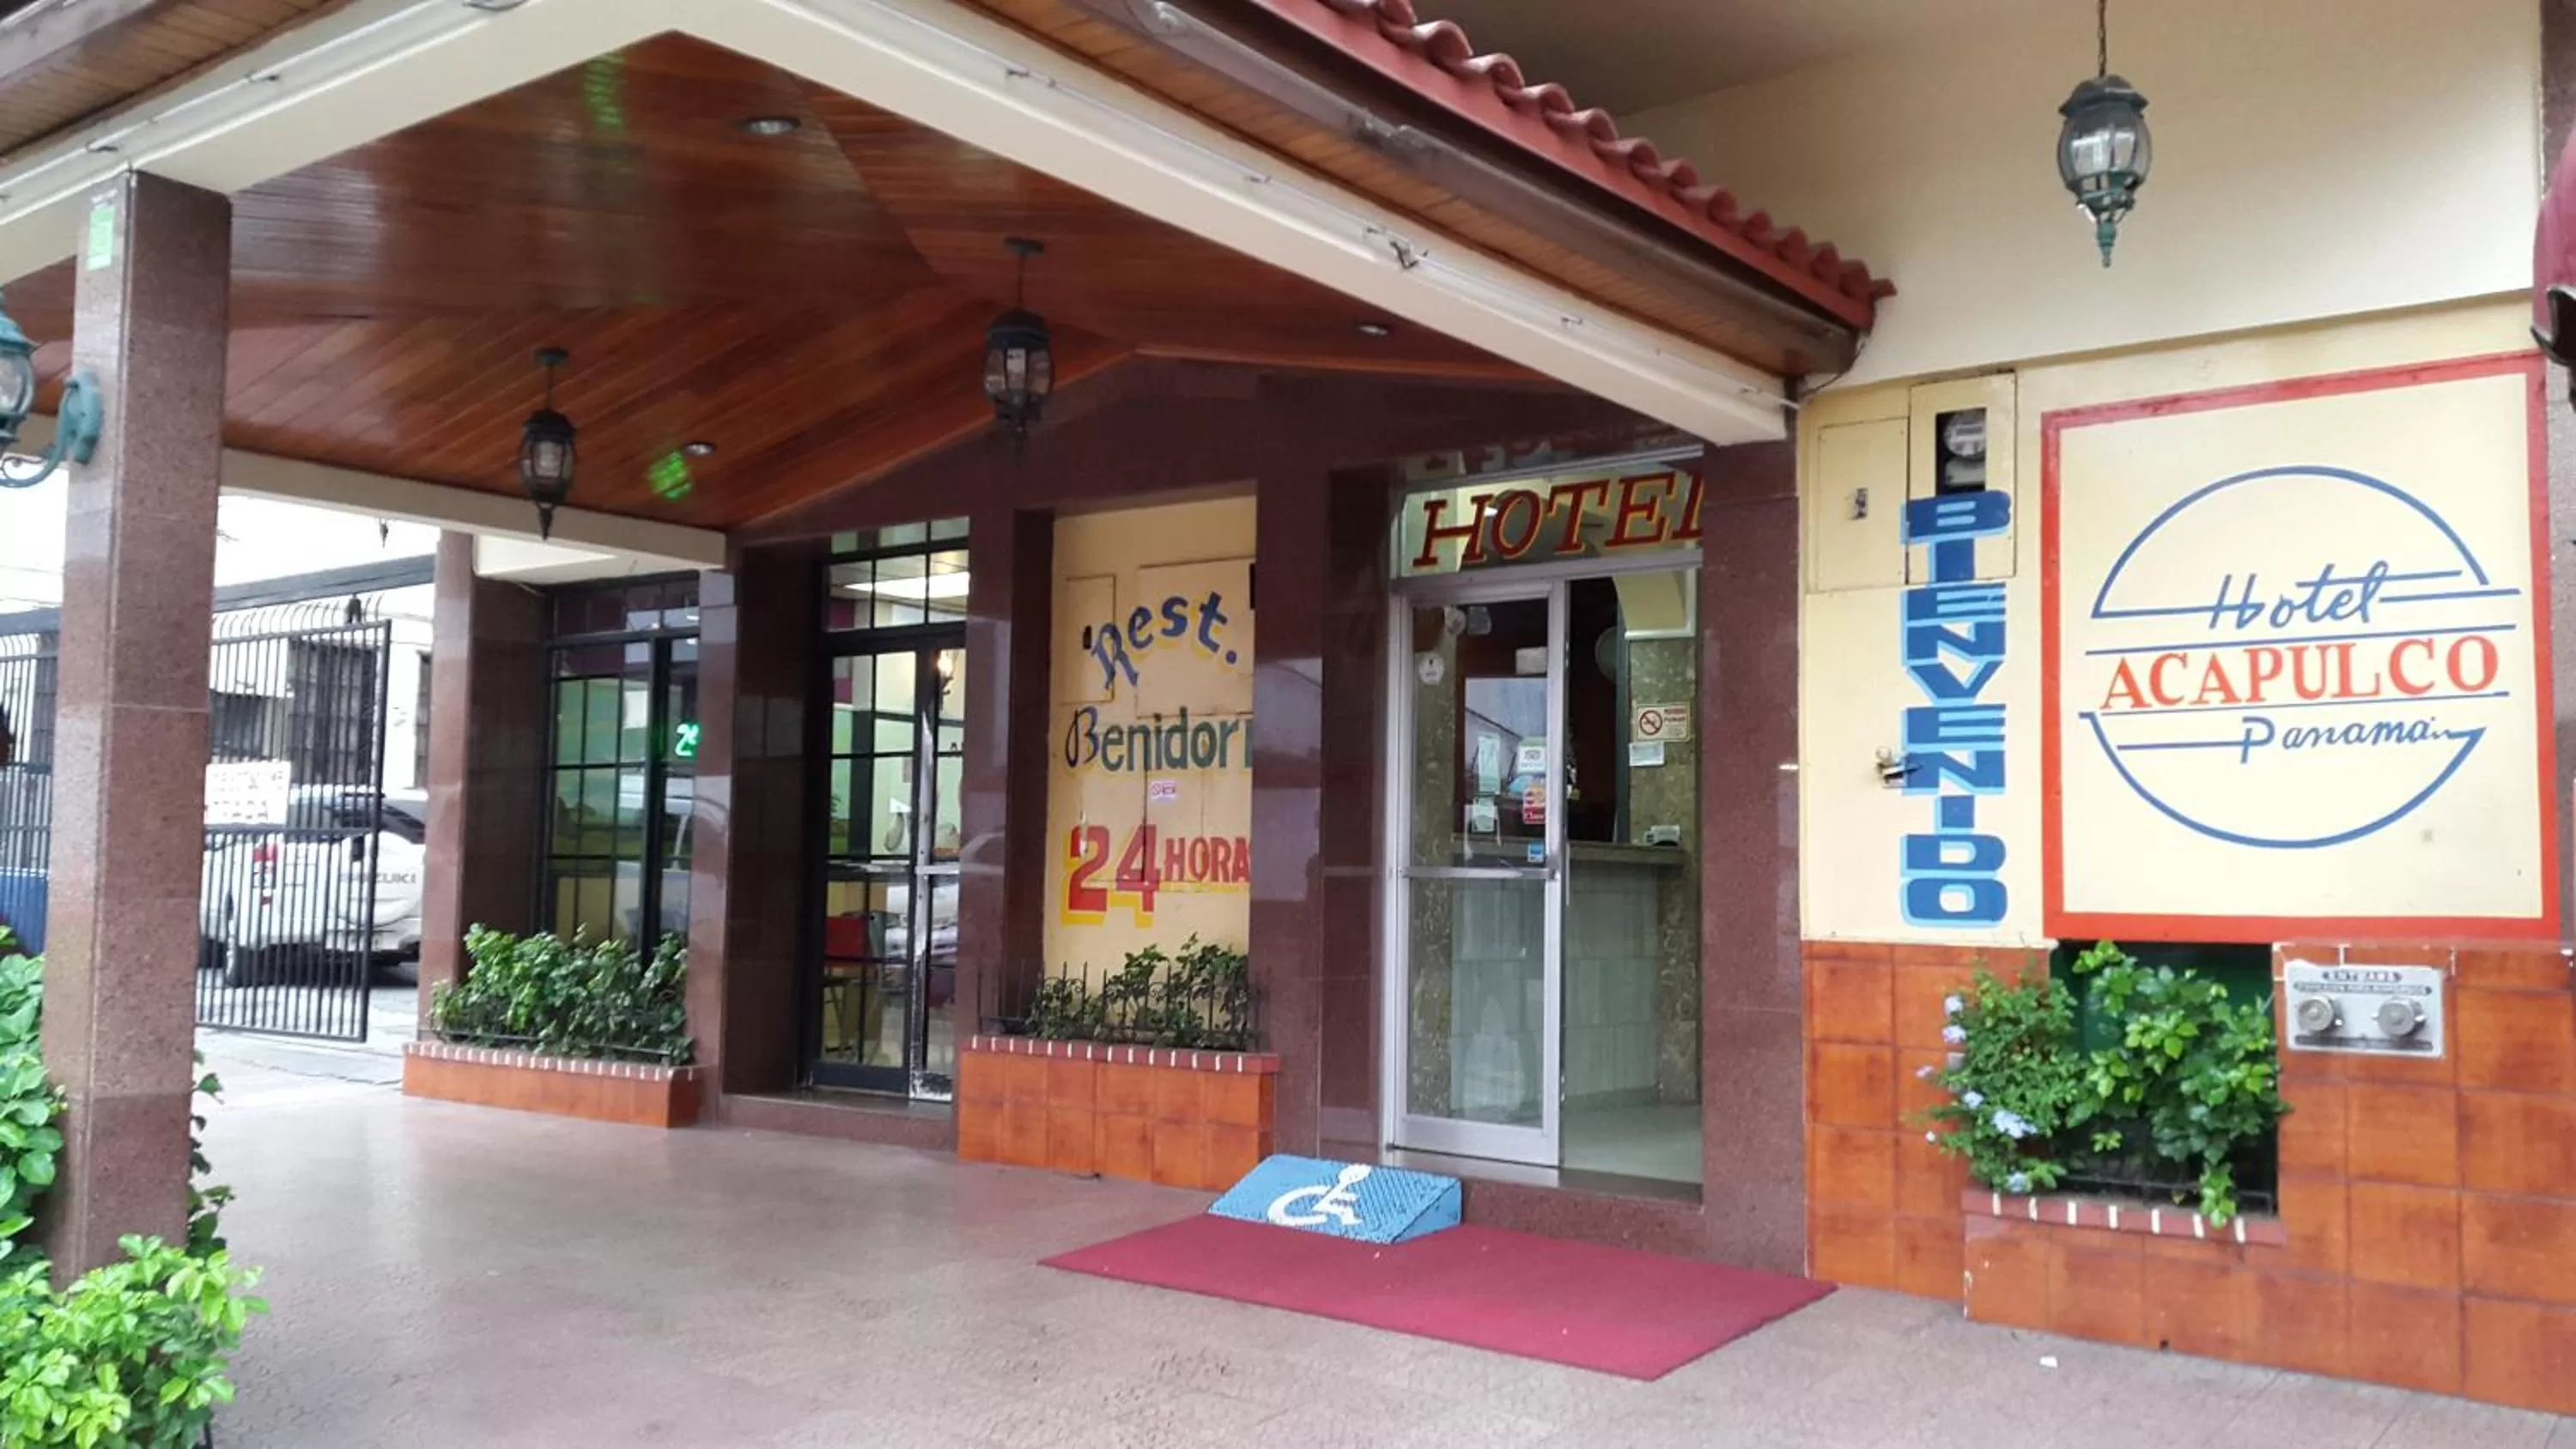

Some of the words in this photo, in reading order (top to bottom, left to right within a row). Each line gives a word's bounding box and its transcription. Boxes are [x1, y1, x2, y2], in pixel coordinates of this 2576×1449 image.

[2208, 561, 2389, 629] Hotel
[1091, 591, 1237, 690] Rest.
[2100, 635, 2500, 710] ACAPULCO
[1066, 706, 1253, 772] Benidor
[1900, 489, 2012, 927] BIENVENIDO
[1067, 823, 1162, 913] 24
[1163, 837, 1251, 883] HORA
